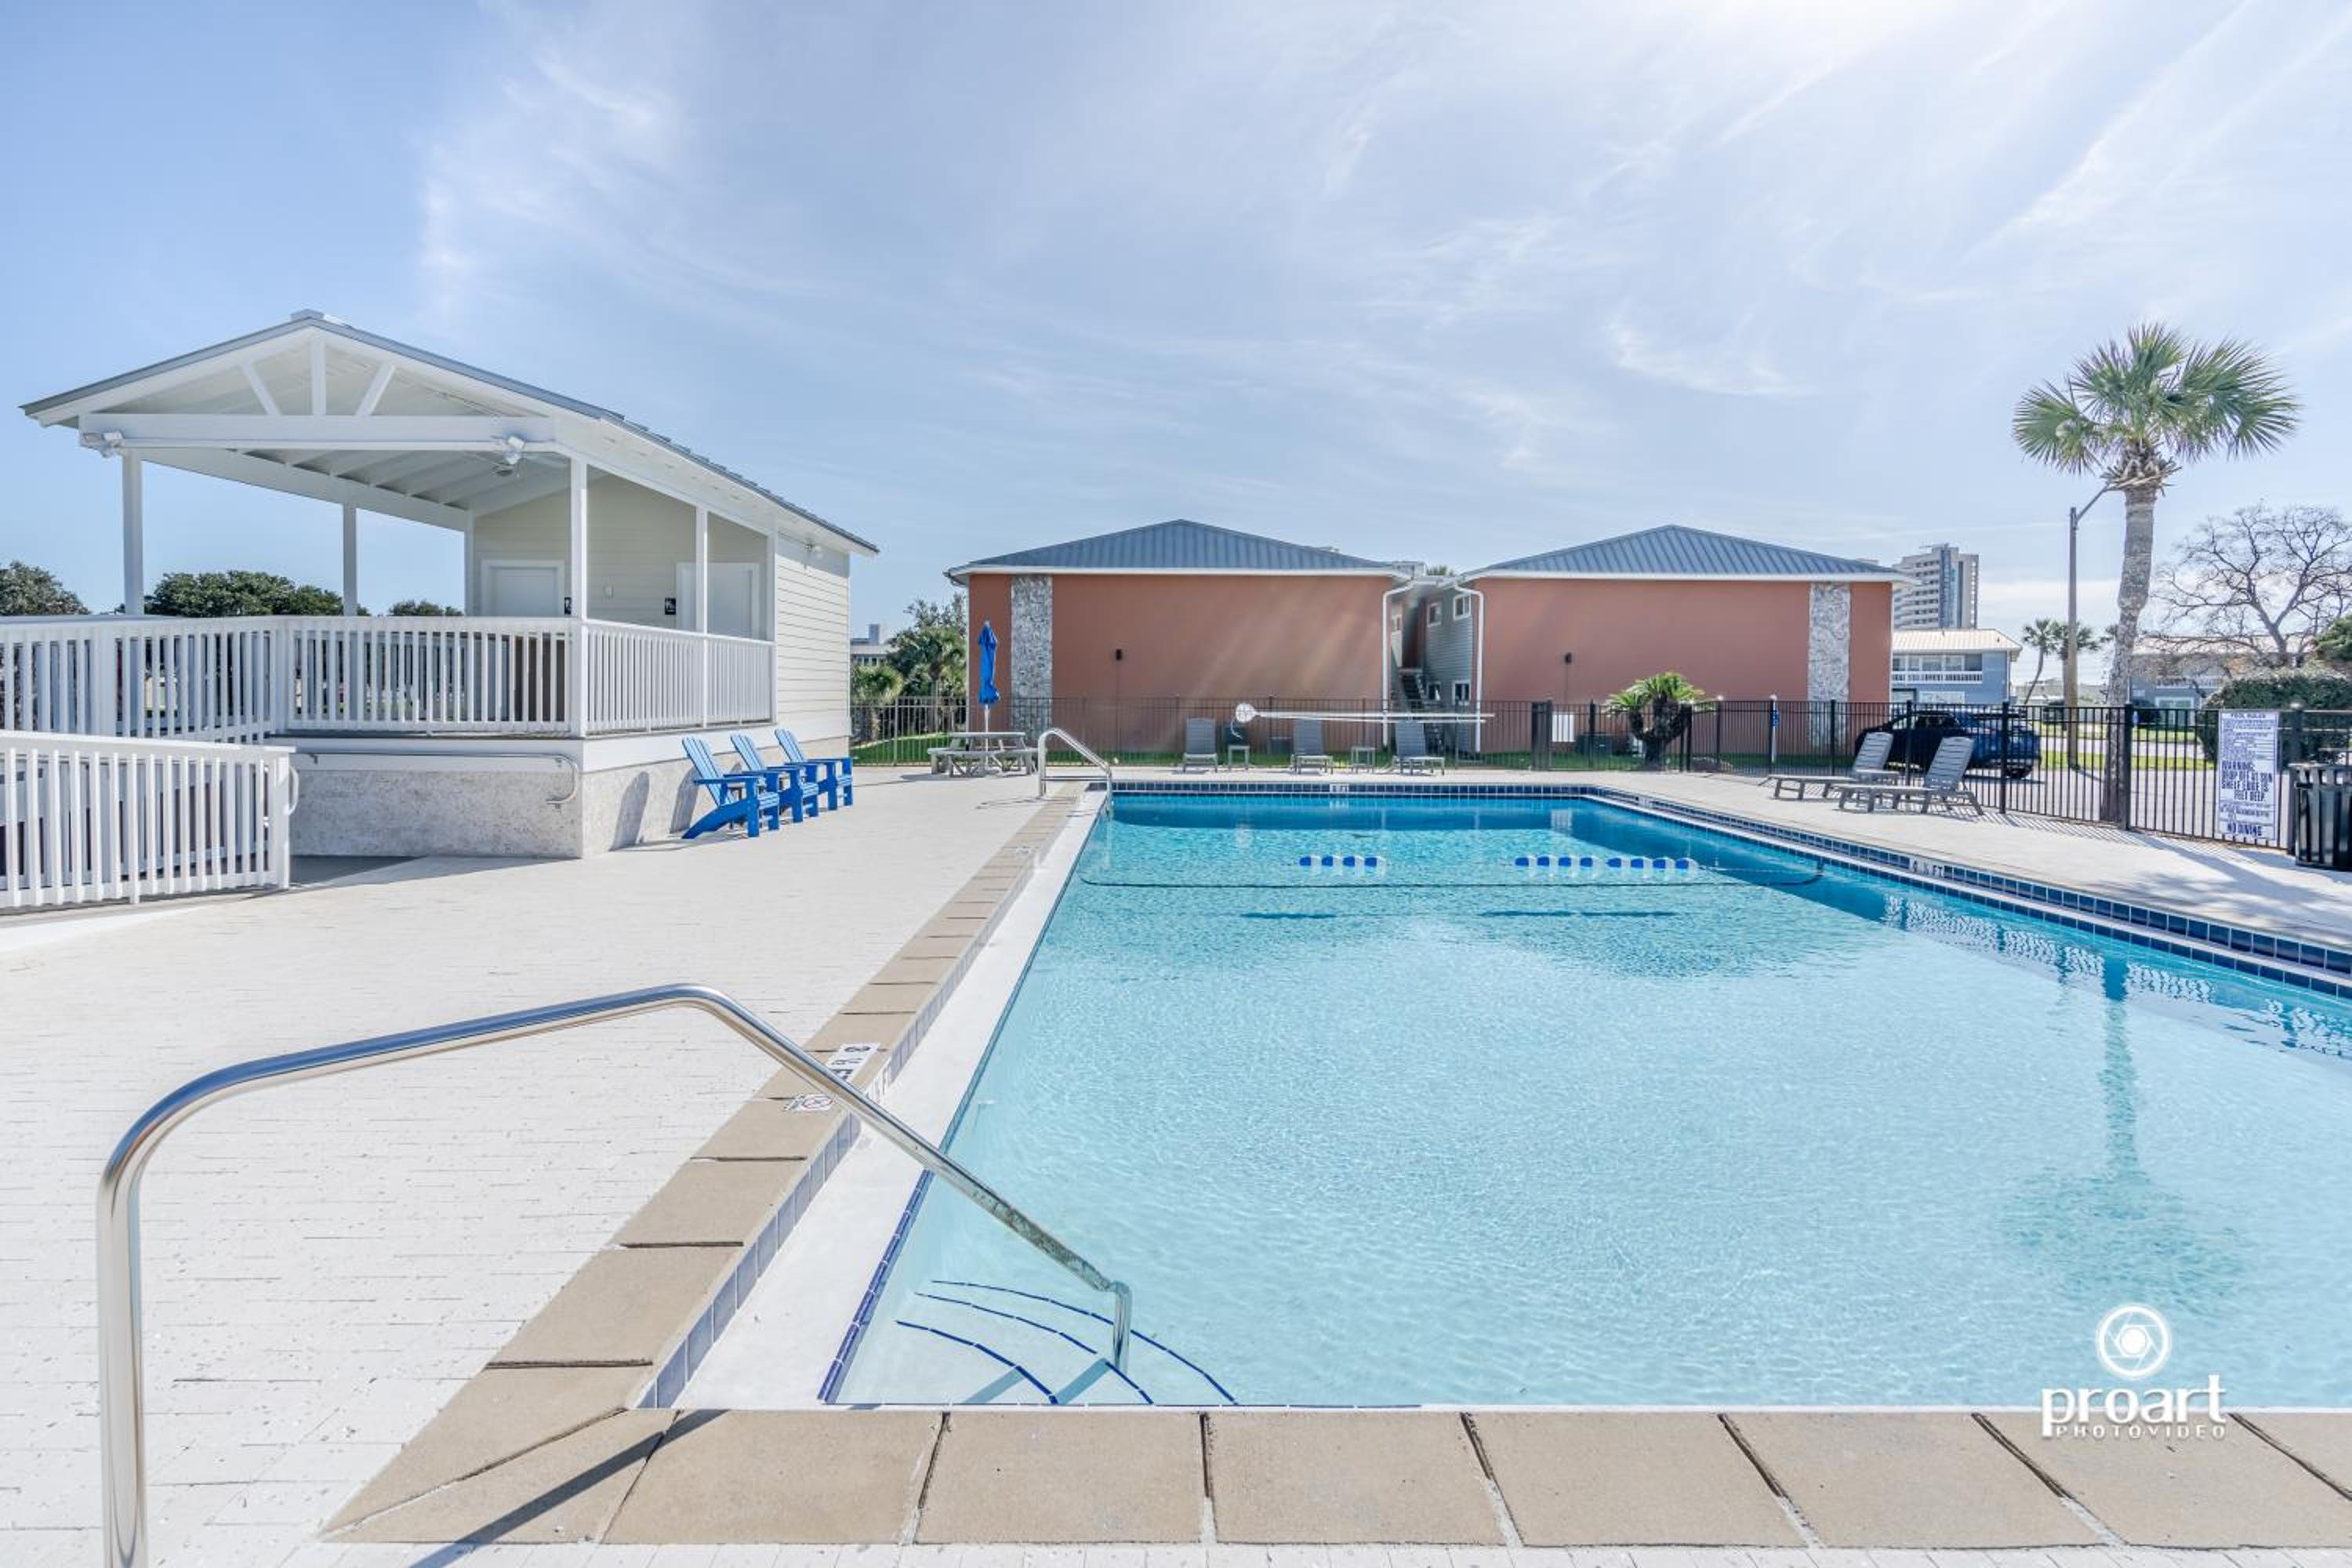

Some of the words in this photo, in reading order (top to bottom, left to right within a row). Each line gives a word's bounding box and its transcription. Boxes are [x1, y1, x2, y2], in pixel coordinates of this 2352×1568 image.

[2222, 760, 2256, 772] WARNING:
[2222, 780, 2240, 789] SHELF
[2234, 790, 2248, 800] FEET
[2228, 823, 2237, 833] NO
